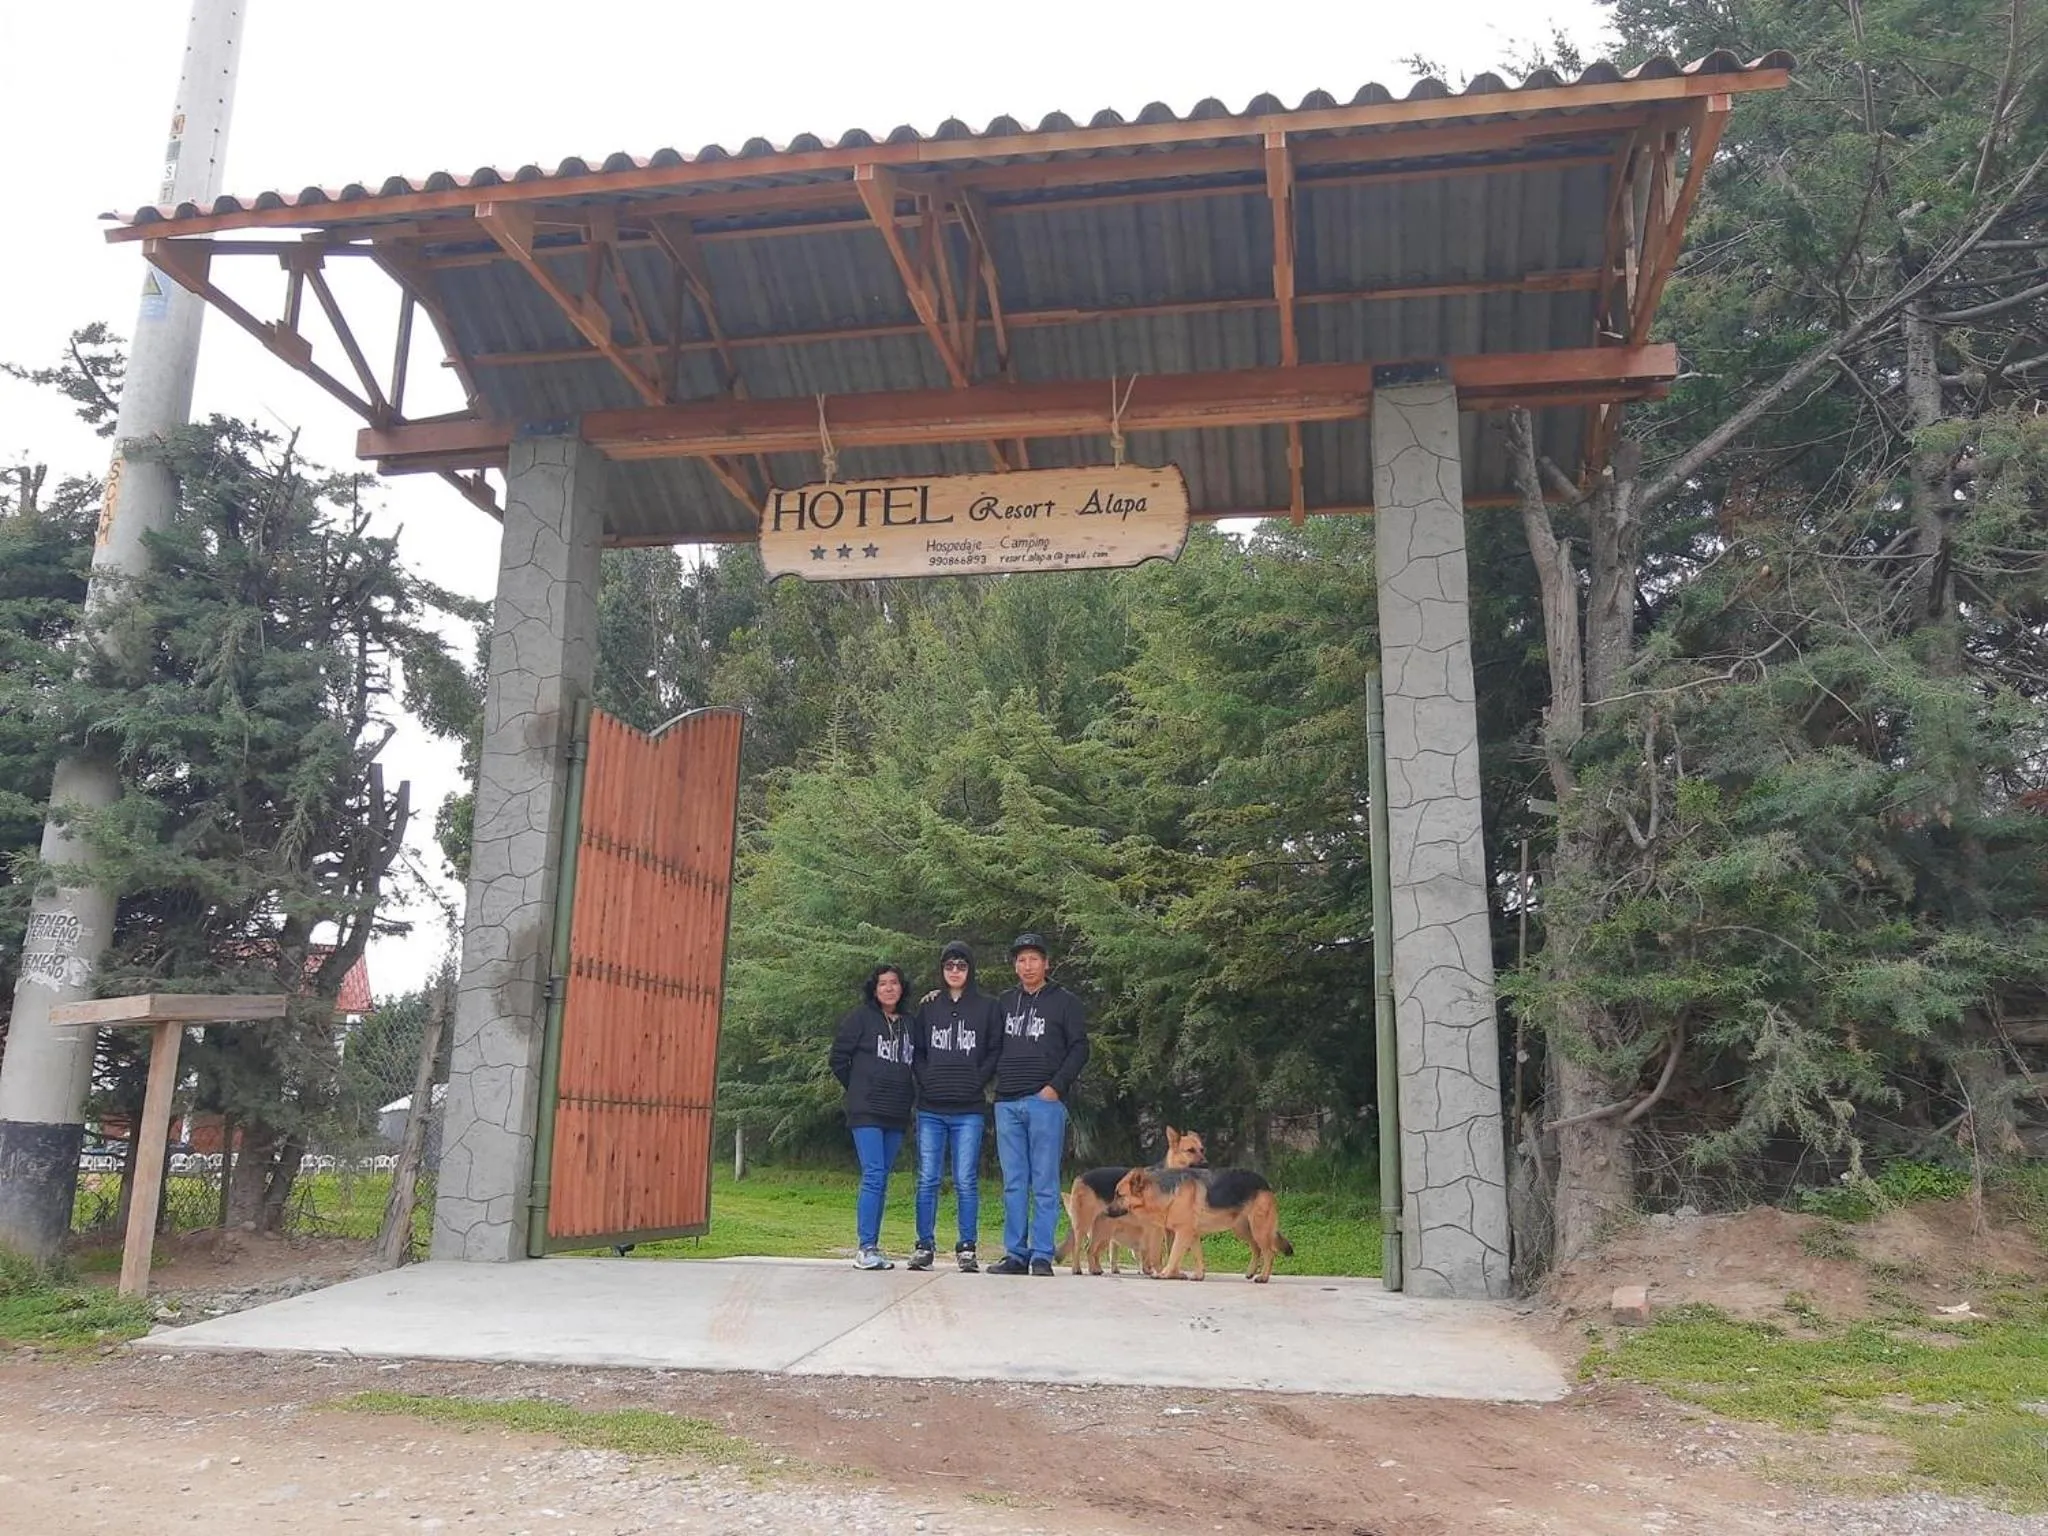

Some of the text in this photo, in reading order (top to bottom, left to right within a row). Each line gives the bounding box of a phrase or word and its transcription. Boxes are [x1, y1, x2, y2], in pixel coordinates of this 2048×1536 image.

[772, 485, 1148, 531] HOTEL Resort Alapa
[926, 535, 1050, 554] Hospedaje Camping
[31, 914, 78, 927] VENDO
[878, 1035, 899, 1062] Resort
[931, 1019, 976, 1056] Resort Alapa
